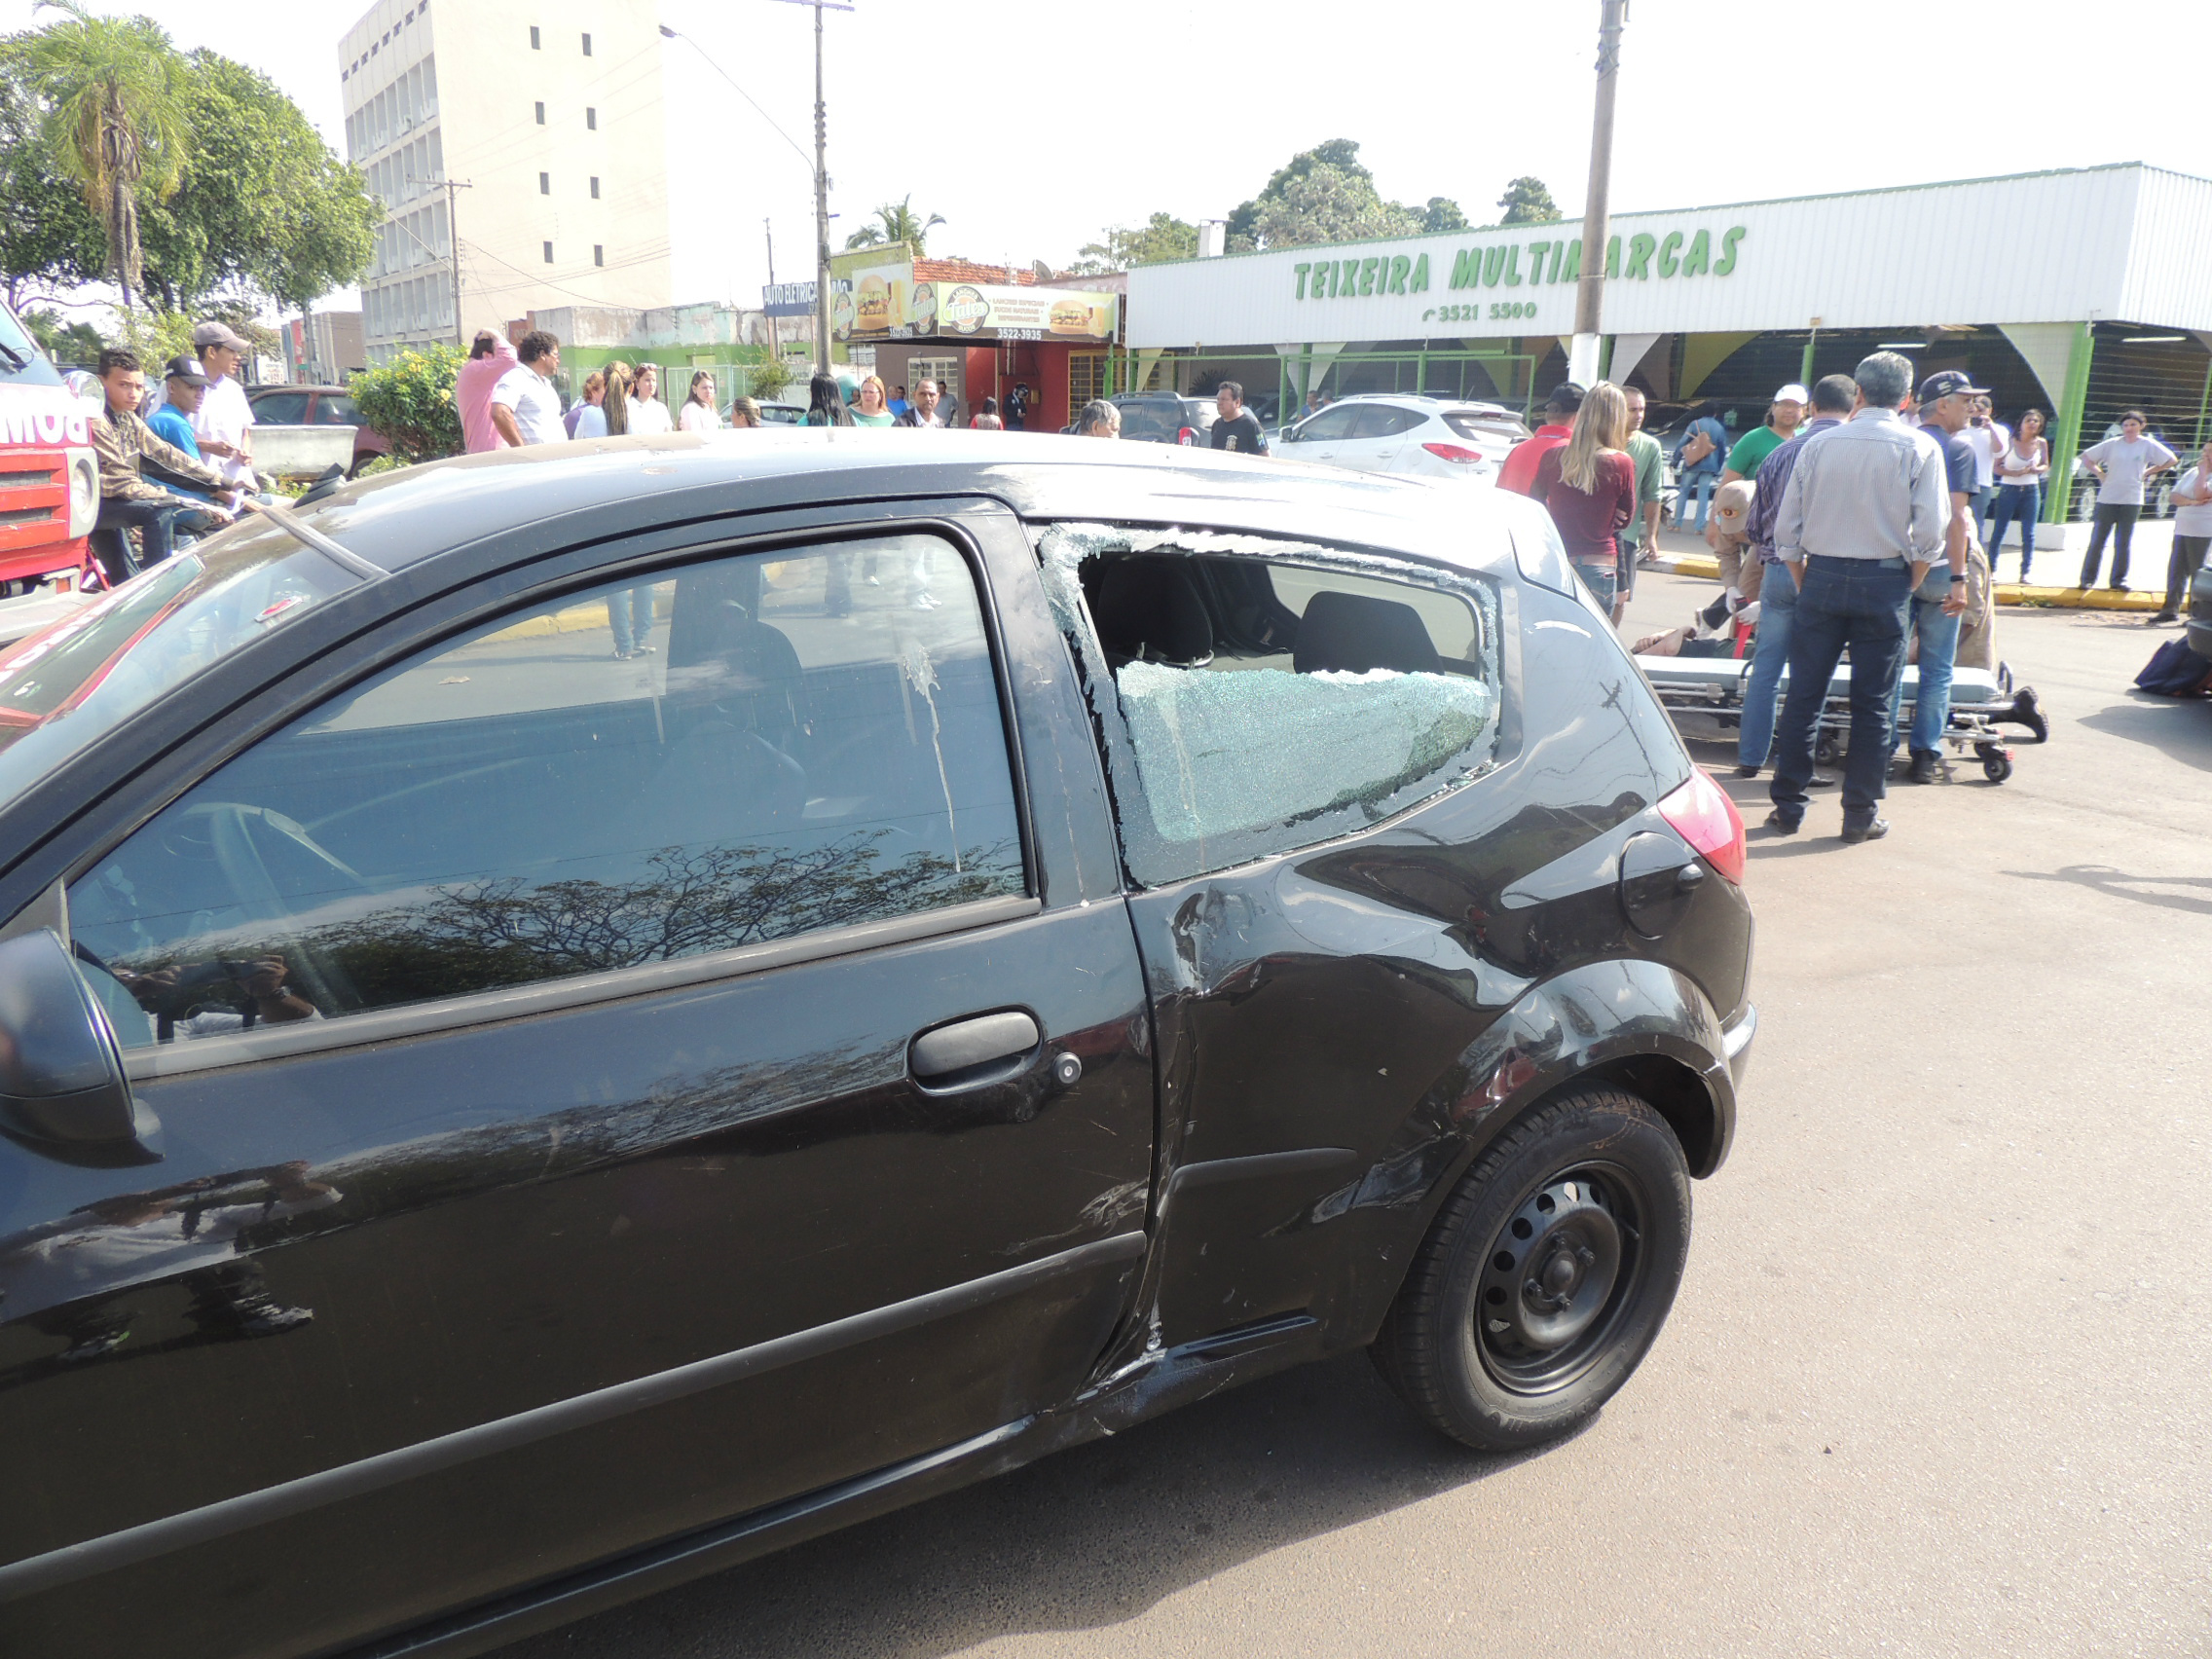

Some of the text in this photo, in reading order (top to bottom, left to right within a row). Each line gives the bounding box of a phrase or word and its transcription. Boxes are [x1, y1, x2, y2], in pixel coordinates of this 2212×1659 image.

[1294, 252, 1429, 300] TEIXEIRA
[764, 285, 784, 306] AUTO
[1439, 302, 1537, 322] 3521 5500
[997, 328, 1042, 340] 3522-3935
